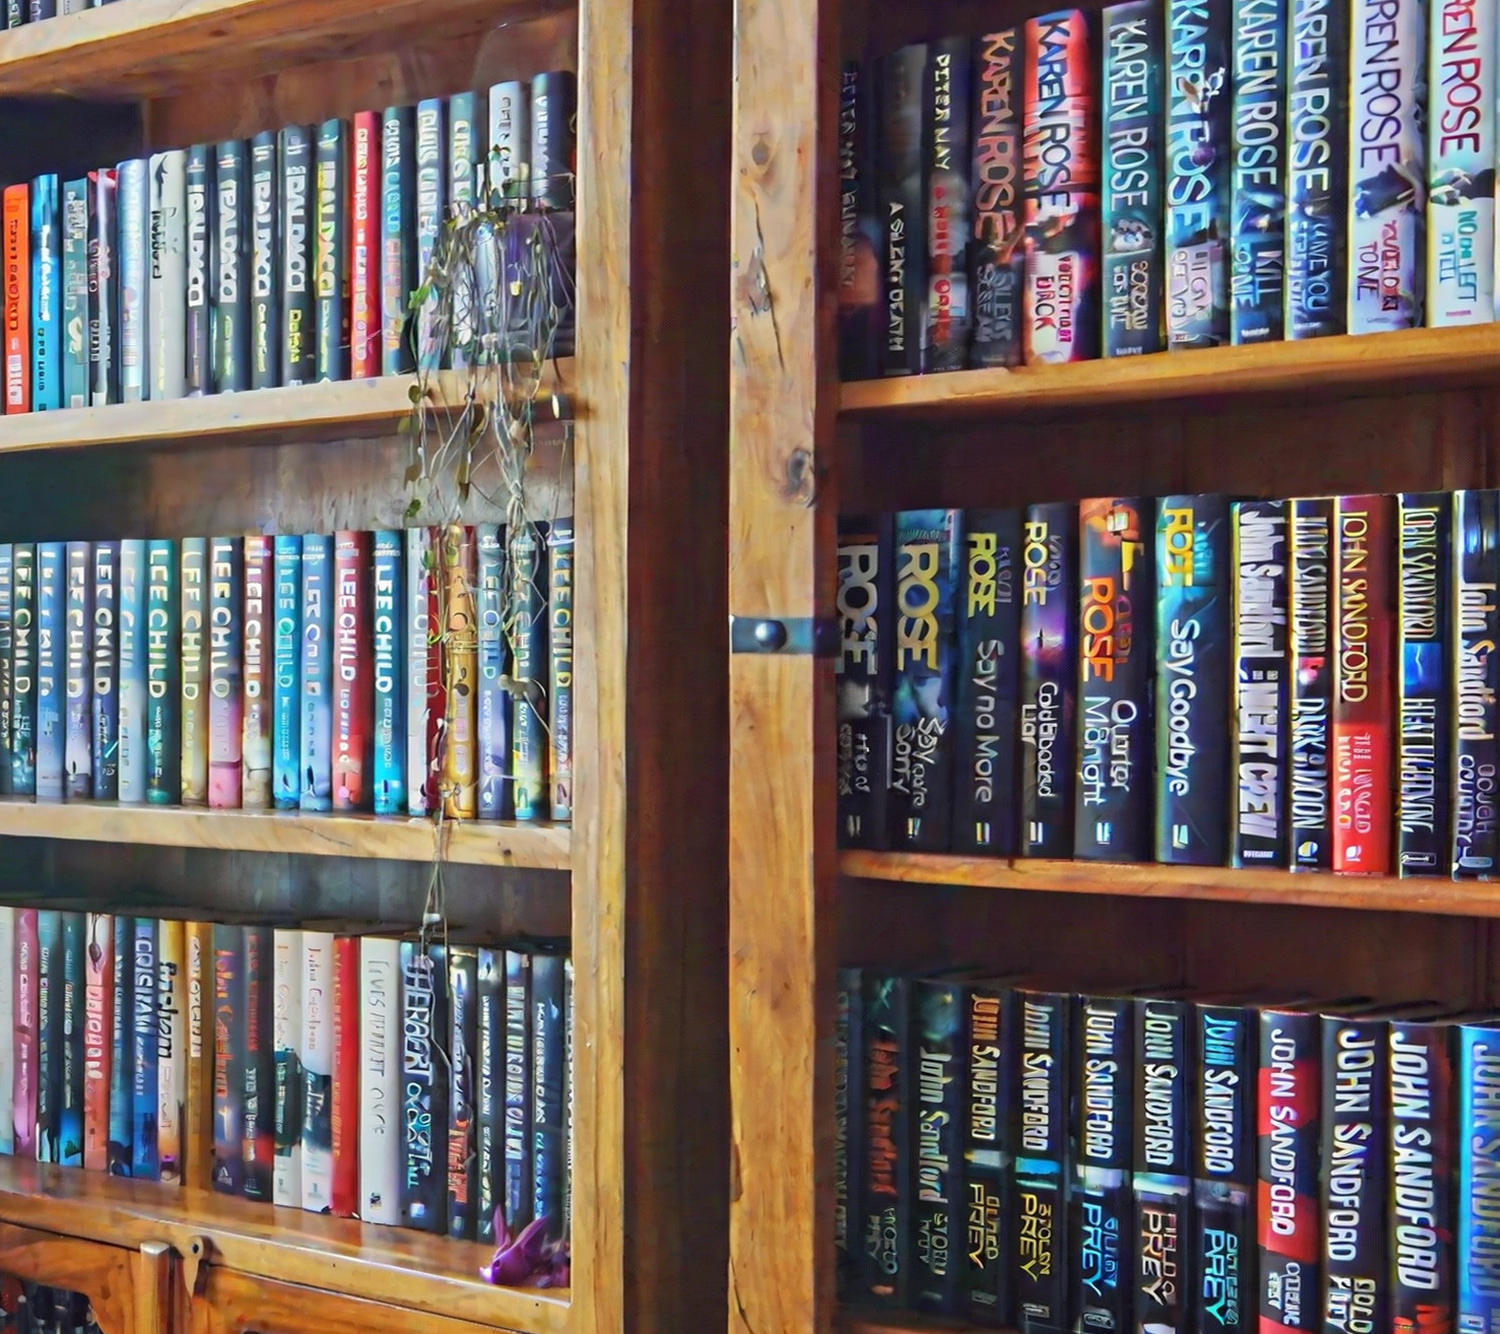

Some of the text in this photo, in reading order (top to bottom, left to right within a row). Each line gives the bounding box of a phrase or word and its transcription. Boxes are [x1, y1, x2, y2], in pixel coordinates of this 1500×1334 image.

[1038, 19, 1071, 208] KAREN ROSE
[1110, 20, 1149, 211] KAREN ROSE
[1237, 100, 1279, 186] ROSE
[1291, 87, 1330, 191] ROSE
[1360, 70, 1401, 168] ROSE
[1440, 59, 1482, 157] ROSE
[975, 137, 1014, 240] ROSE
[1168, 121, 1210, 237] ROSE
[246, 568, 262, 614] LEE
[897, 543, 939, 671] ROSE
[1024, 522, 1047, 605] ROSE
[149, 609, 168, 698] CHILD
[182, 610, 201, 700] CHILD
[340, 569, 356, 681] LEE CHILD
[375, 565, 392, 693] LEE CHILD
[1084, 578, 1113, 682] ROSE
[972, 640, 1004, 802] Say no More
[1164, 619, 1200, 796] Say Goodbye
[1085, 1059, 1117, 1158] SANDFORD
[1270, 1029, 1296, 1097] JOHN
[1390, 1031, 1429, 1118] JOHN
[1144, 1064, 1178, 1166] SANDFORD
[1328, 1030, 1375, 1261] JOHN SANDFORD
[1204, 1069, 1238, 1326] SANDFORD PREY
[1269, 1106, 1295, 1236] SANDFORD
[1392, 1125, 1439, 1290] SANDFORD
[1020, 1193, 1037, 1282] PREY
[1082, 1202, 1101, 1296] PREY
[1141, 1211, 1163, 1305] PREY
